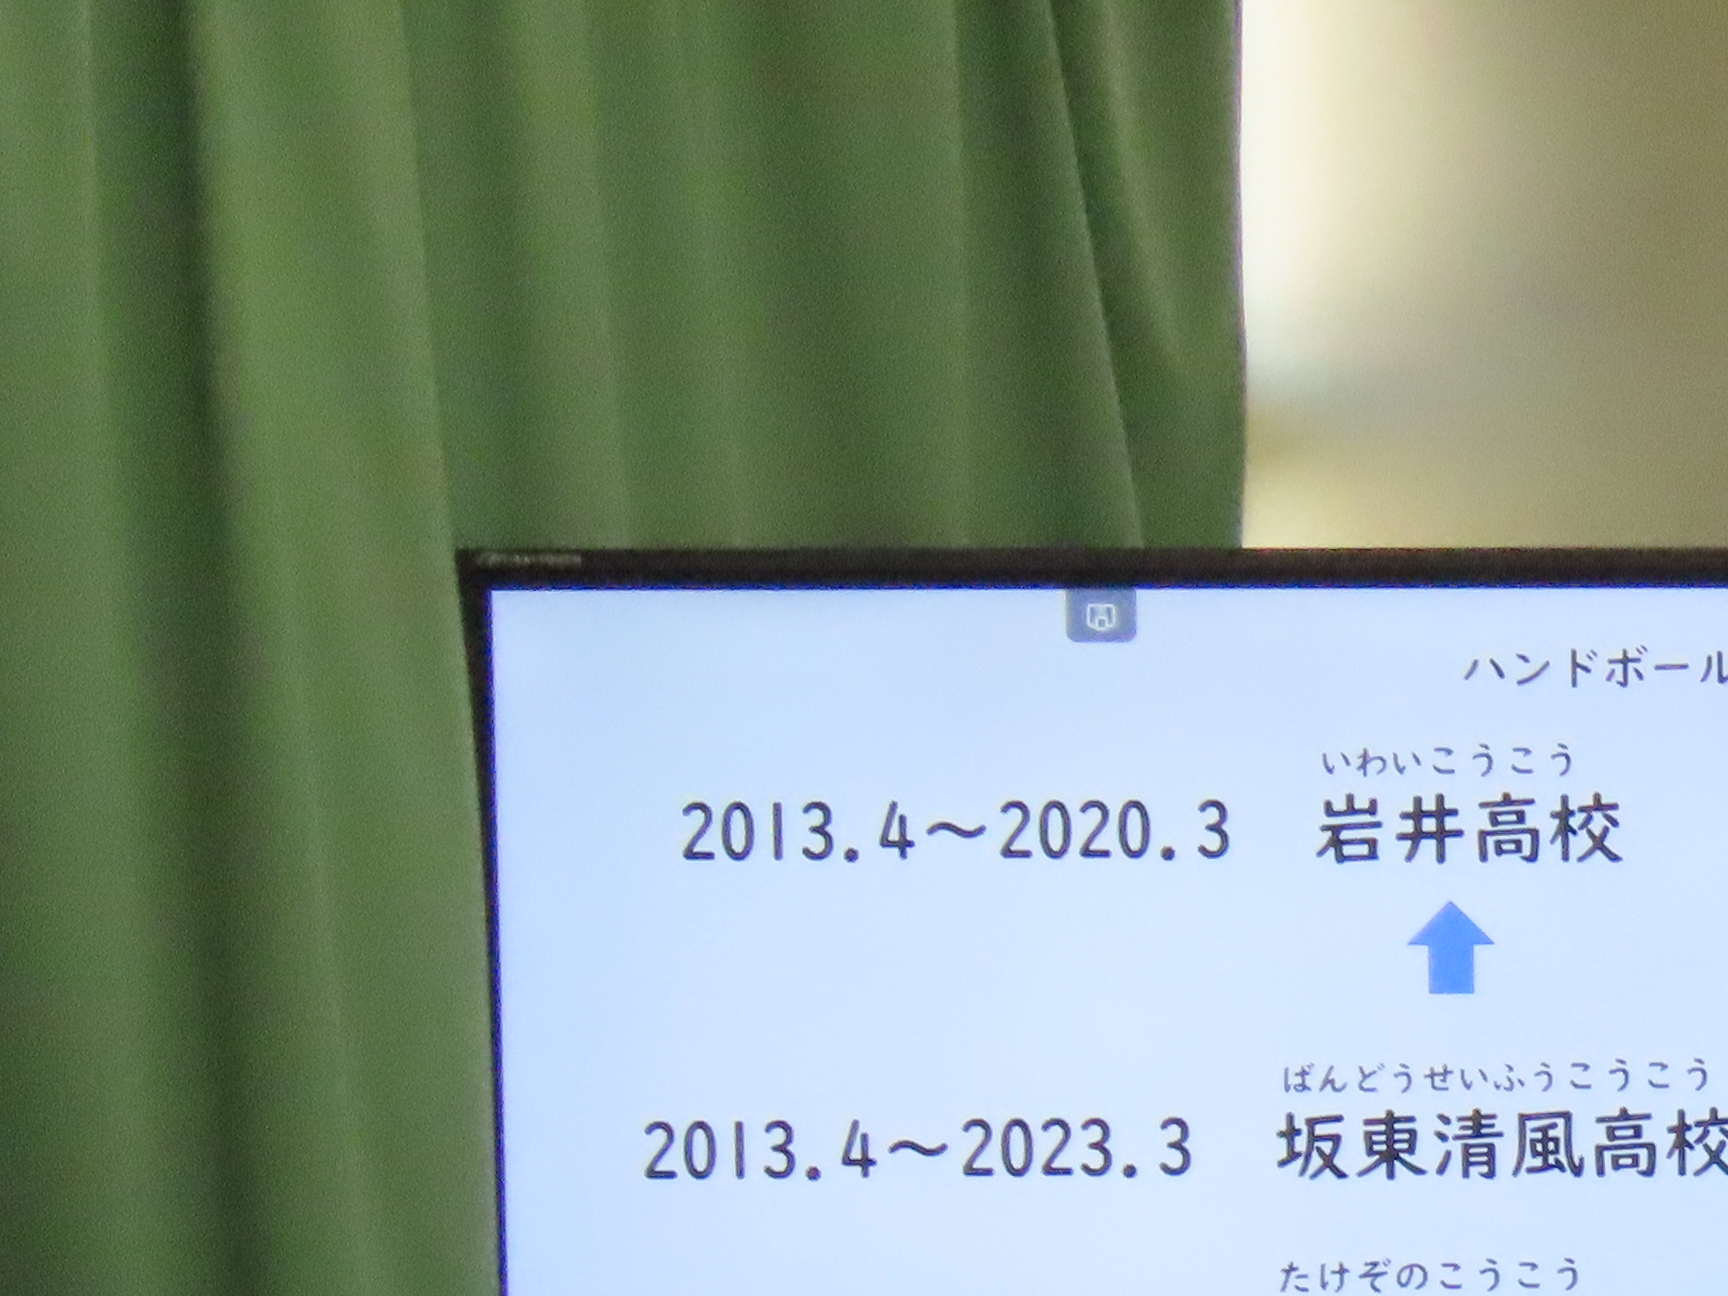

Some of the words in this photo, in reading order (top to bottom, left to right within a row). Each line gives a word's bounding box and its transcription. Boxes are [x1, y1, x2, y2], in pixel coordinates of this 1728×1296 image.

[1322, 743, 1574, 778] いわいこうこう
[682, 799, 1231, 864] 2013.4～2020.3
[1316, 791, 1624, 866] 岩井高校
[1283, 1058, 1710, 1094] ばんどうせいふうこうこう
[644, 1116, 1192, 1182] 2013.4～2023.3
[1279, 1257, 1580, 1294] たけぞのこうこう
